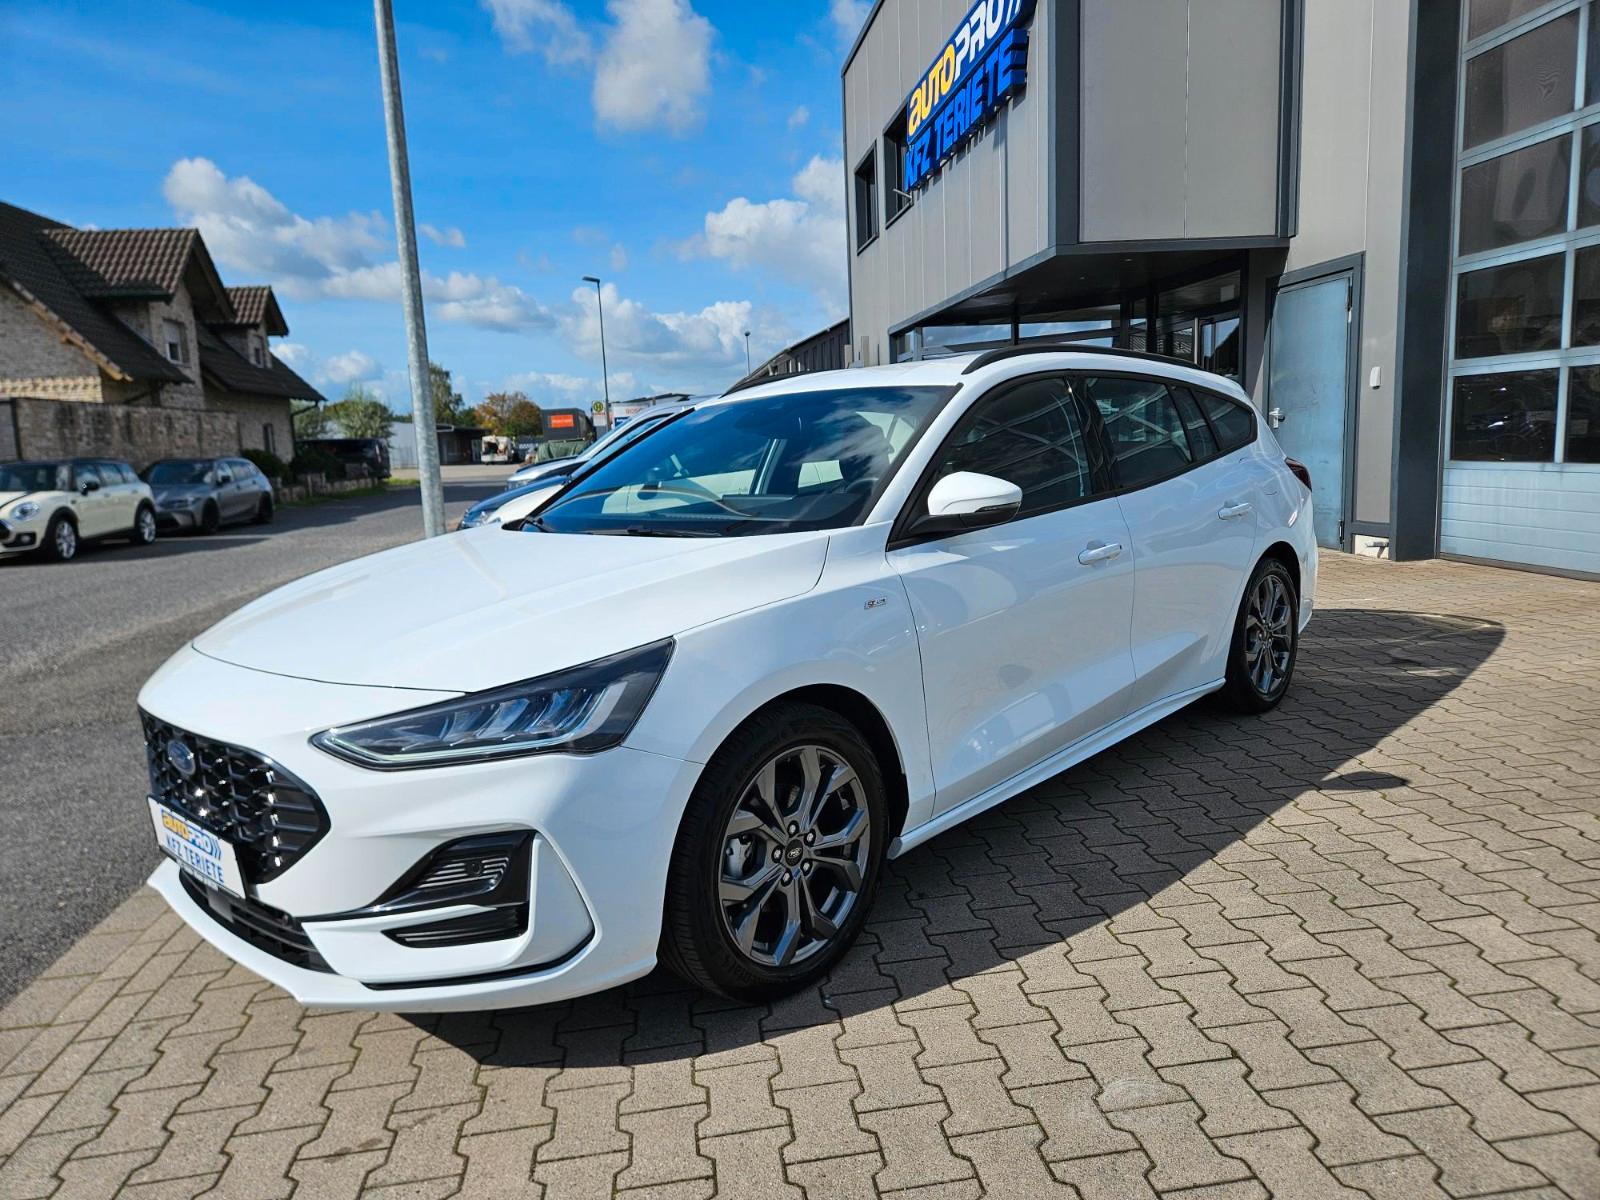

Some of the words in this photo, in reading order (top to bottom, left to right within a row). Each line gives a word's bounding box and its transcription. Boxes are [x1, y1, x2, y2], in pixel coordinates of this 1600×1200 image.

[904, 126, 931, 192] KFZ
[935, 29, 1013, 161] TERIETE
[183, 845, 225, 884] TERIETE
